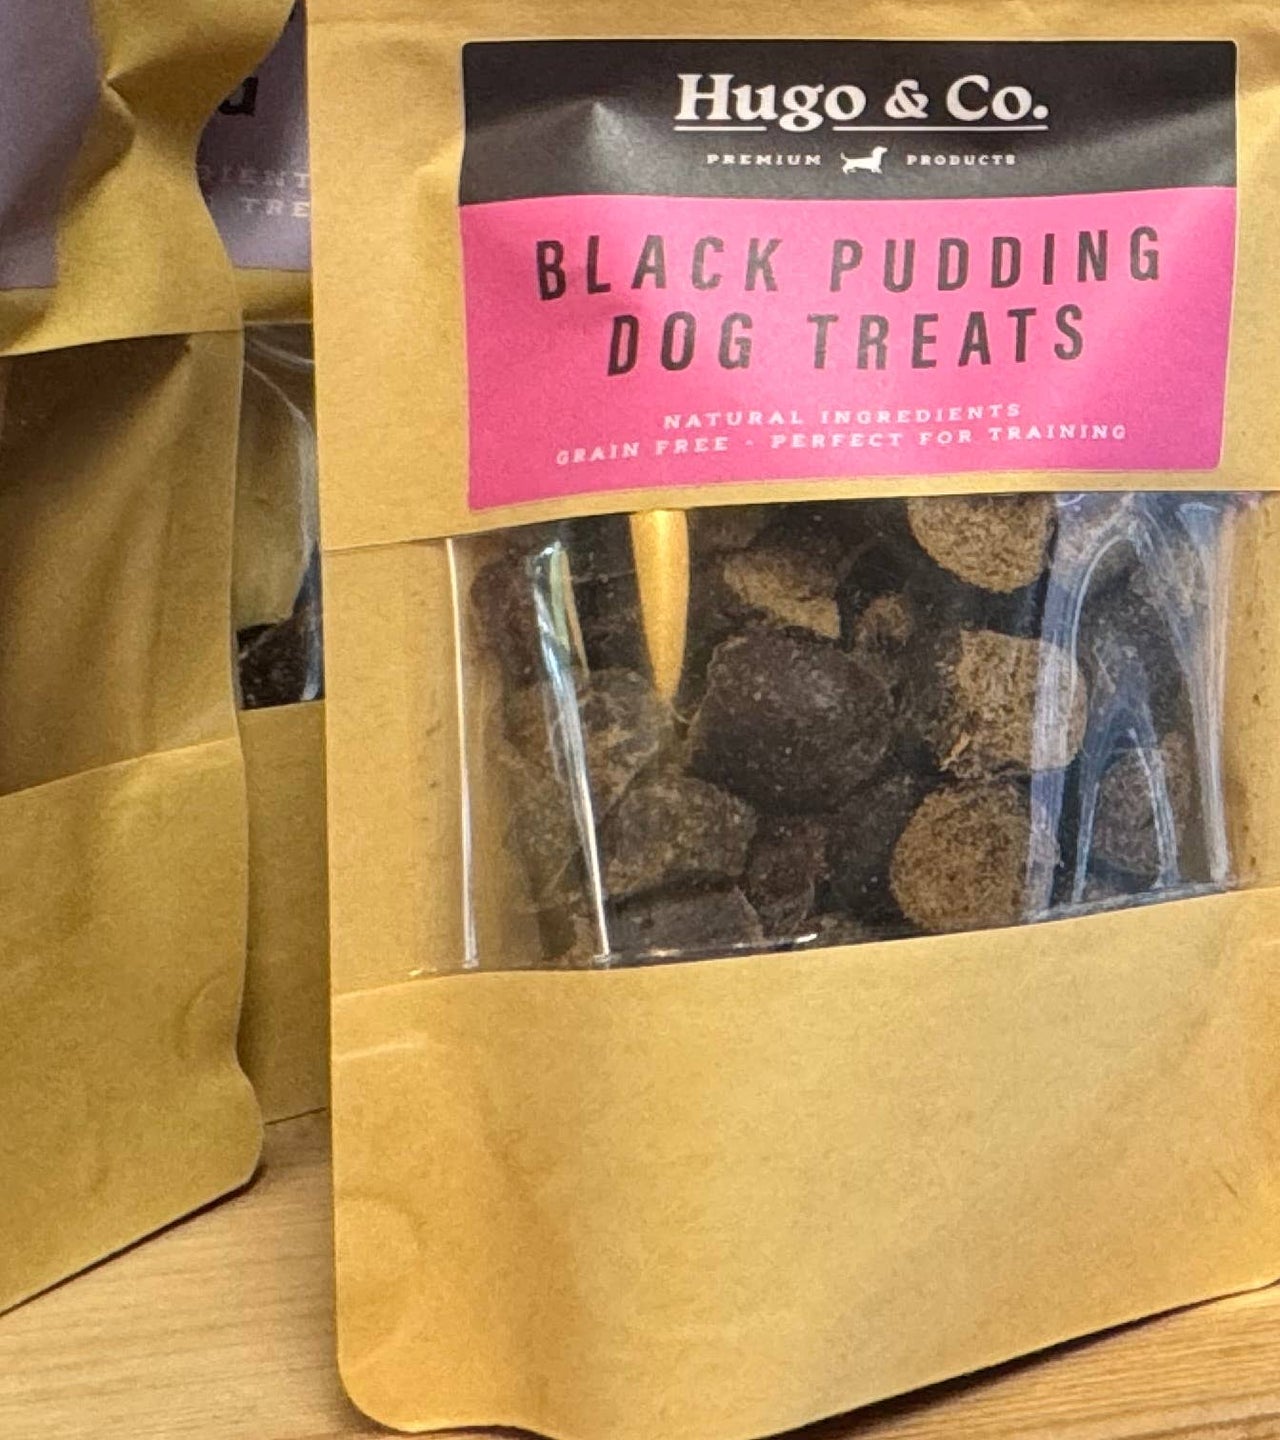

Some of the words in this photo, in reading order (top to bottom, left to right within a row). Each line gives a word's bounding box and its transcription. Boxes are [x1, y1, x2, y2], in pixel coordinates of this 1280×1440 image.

[674, 73, 867, 131] Hugo
[884, 79, 929, 119] &
[946, 74, 1049, 122] Co.
[706, 153, 822, 166] PREMIUM
[906, 154, 1016, 166] PRODUCTS
[536, 234, 780, 302] BLACK
[831, 226, 1160, 293] PUDDING
[607, 311, 752, 377] DOG
[807, 303, 1083, 370] TREATS
[664, 410, 804, 429] NATURAL
[821, 403, 1021, 425] INGREDIENTS
[556, 441, 640, 465] GRAIN
[655, 436, 729, 456] FREE
[770, 432, 903, 449] PERFECT
[919, 428, 973, 446] FOR
[988, 423, 1126, 441] TRAINING
